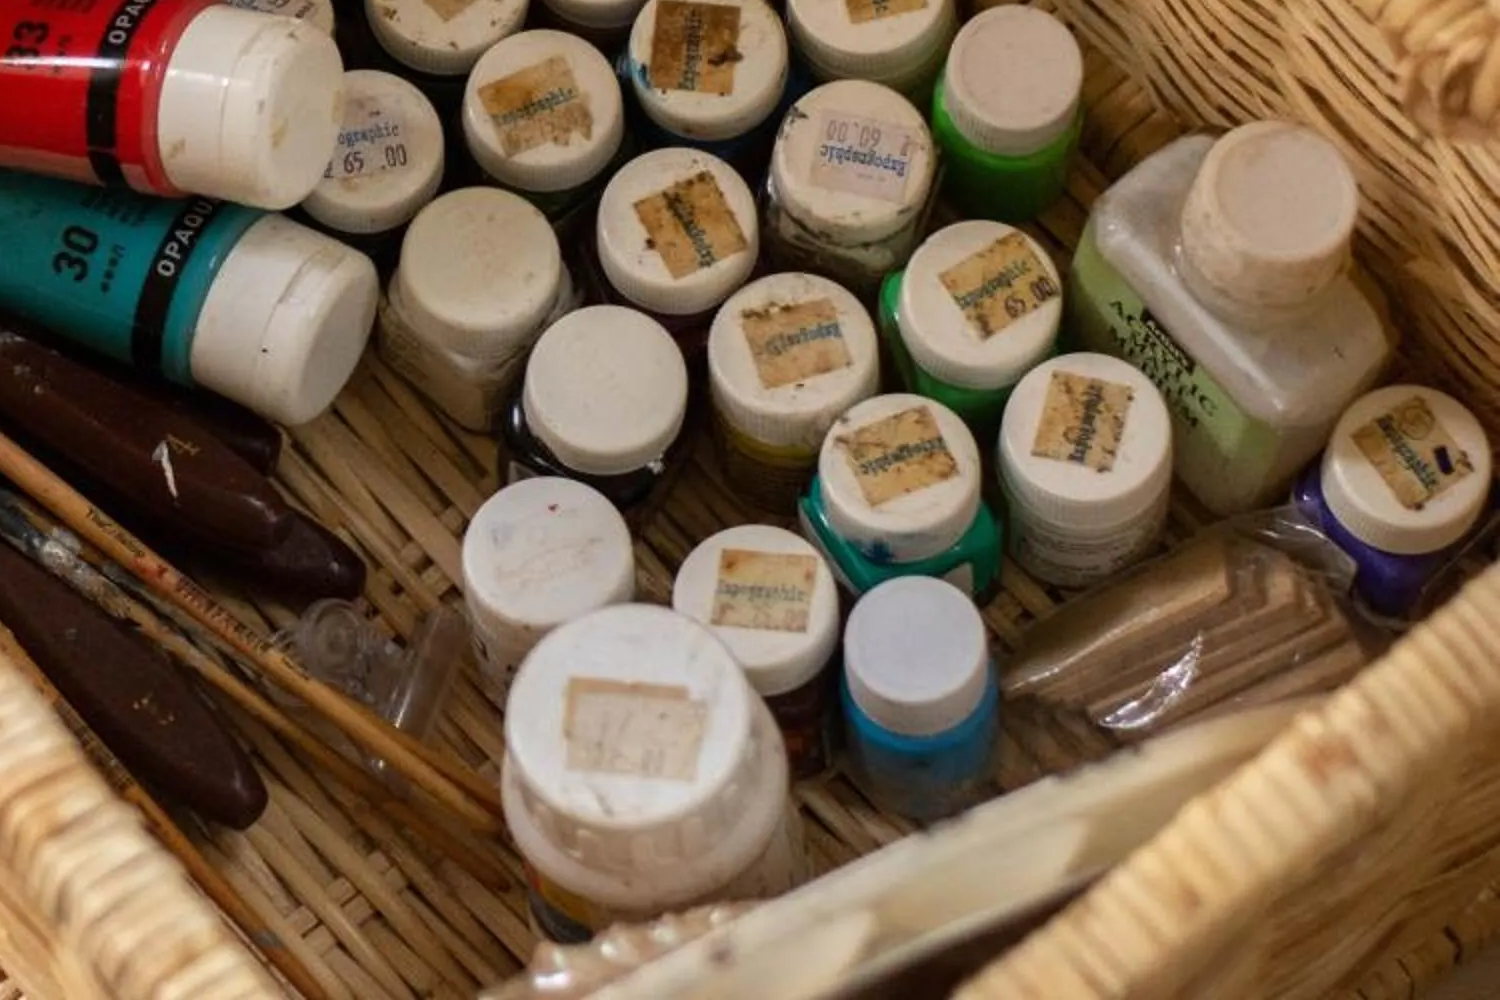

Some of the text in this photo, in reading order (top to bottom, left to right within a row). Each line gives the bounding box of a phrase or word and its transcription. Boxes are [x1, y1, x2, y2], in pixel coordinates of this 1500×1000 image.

[336, 121, 400, 149] ographic
[816, 139, 908, 179] Expographic
[52, 225, 100, 282] 30
[156, 199, 214, 277] OPAQU
